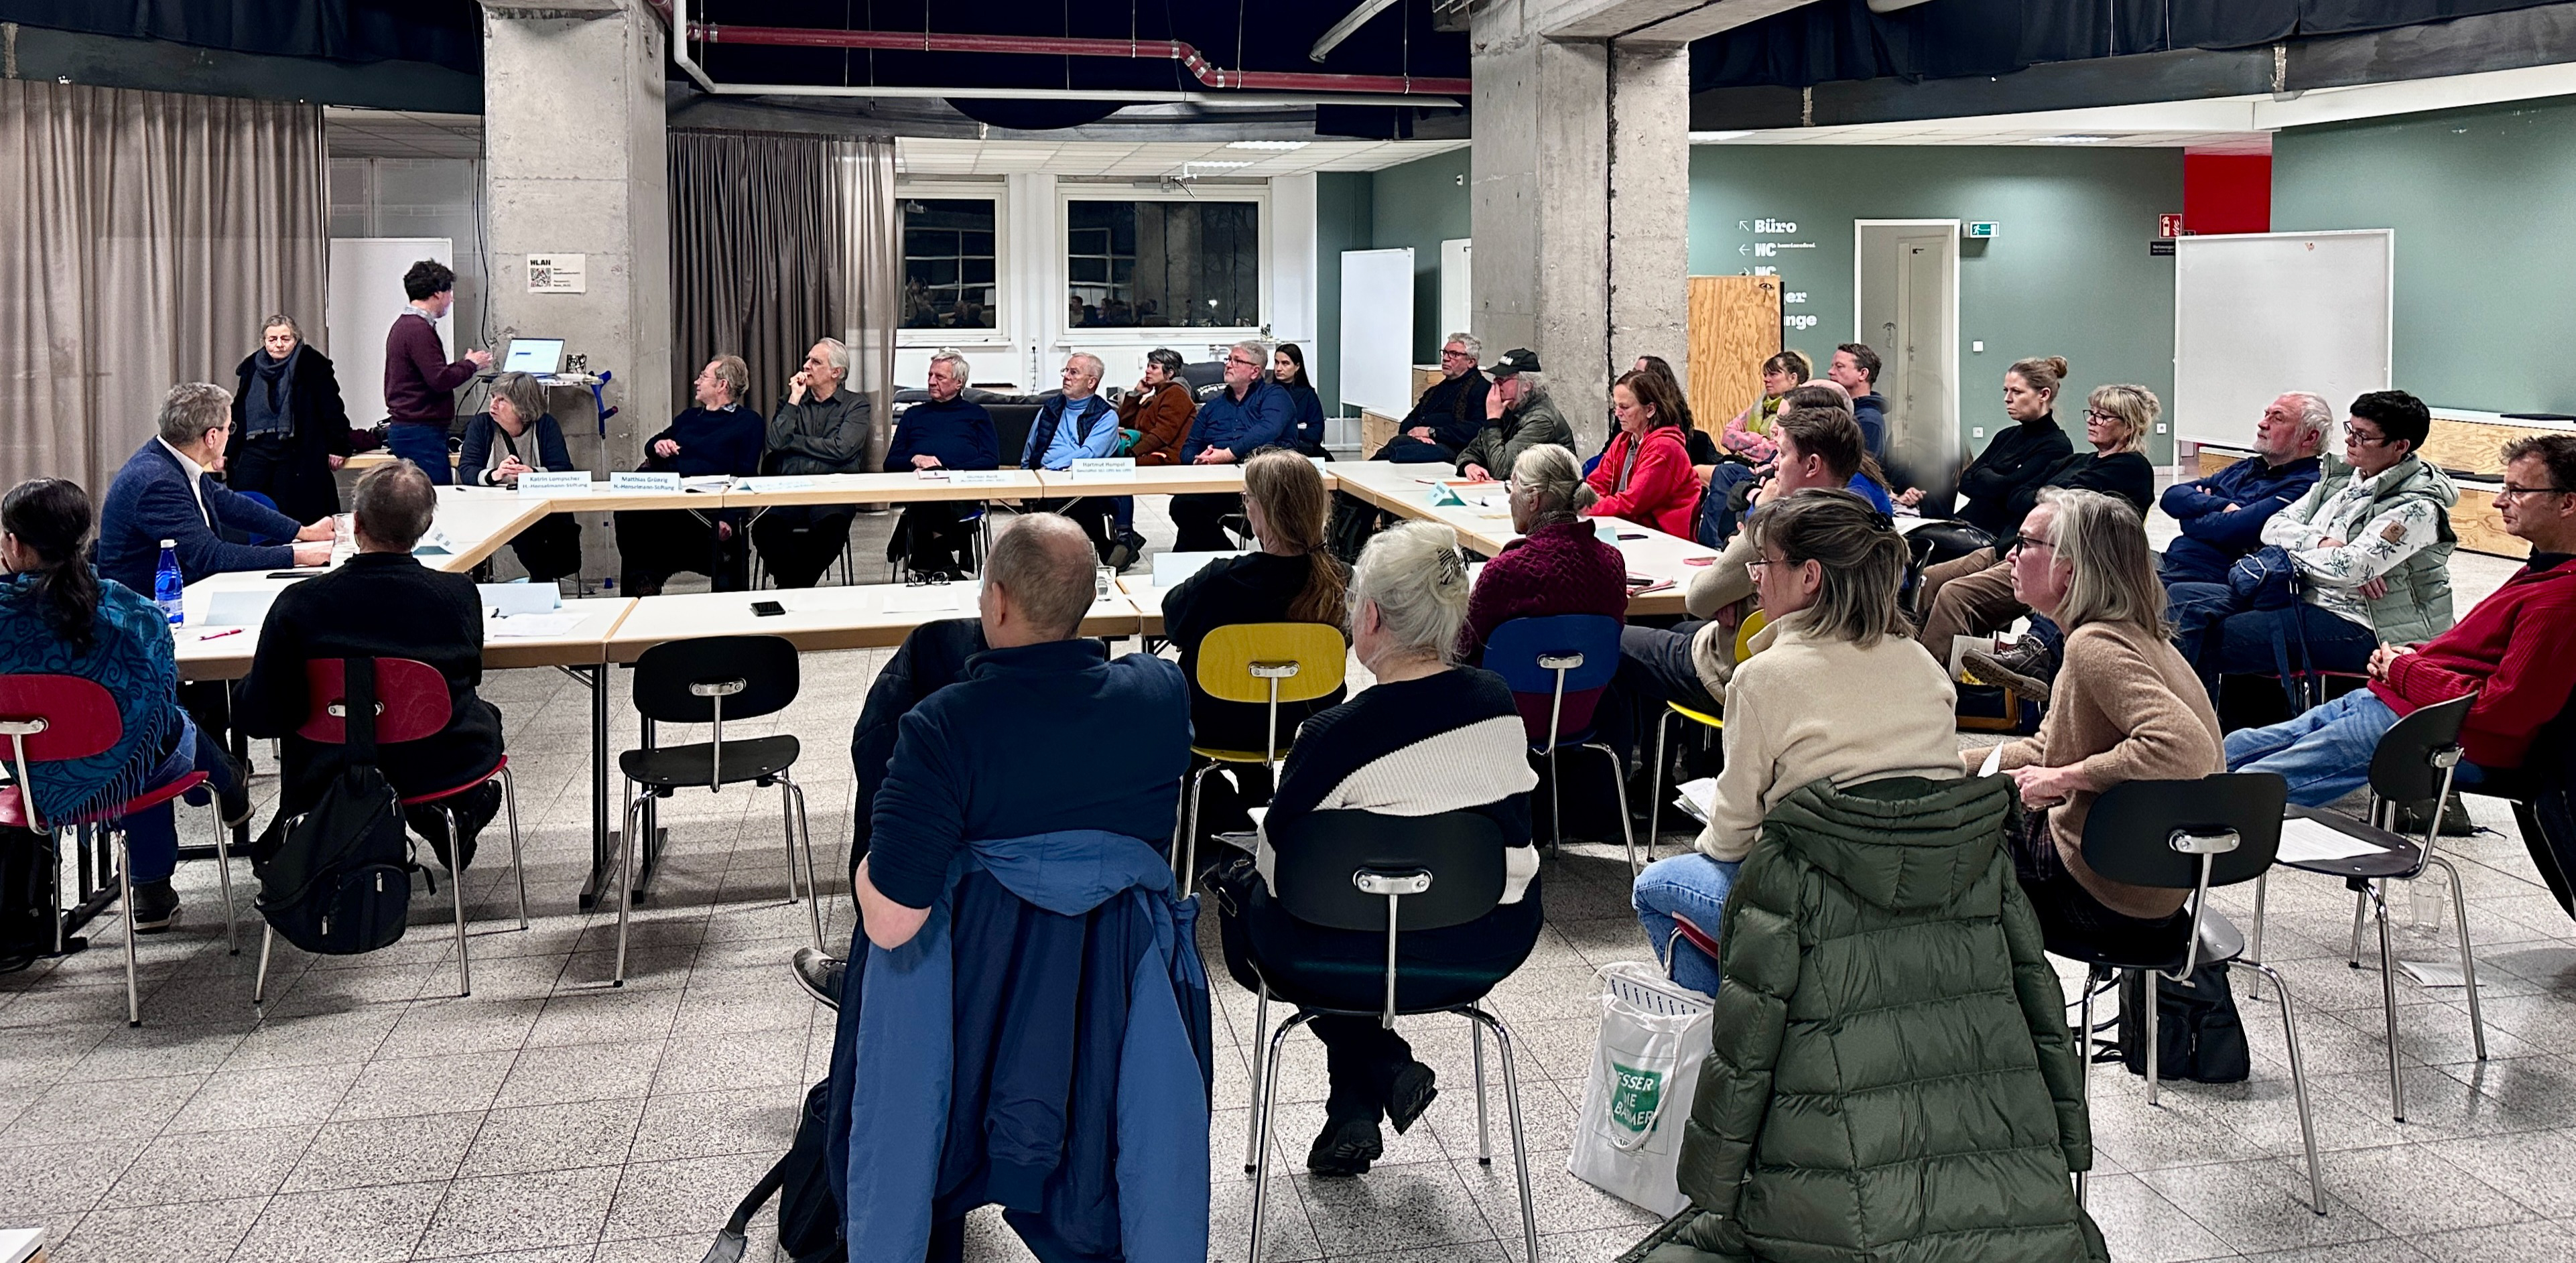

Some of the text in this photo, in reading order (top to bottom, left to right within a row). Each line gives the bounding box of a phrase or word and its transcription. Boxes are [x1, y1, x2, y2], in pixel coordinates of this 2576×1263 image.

[1754, 218, 1797, 233] Büro
[1754, 243, 1777, 257] WC
[1784, 315, 1817, 330] nge
